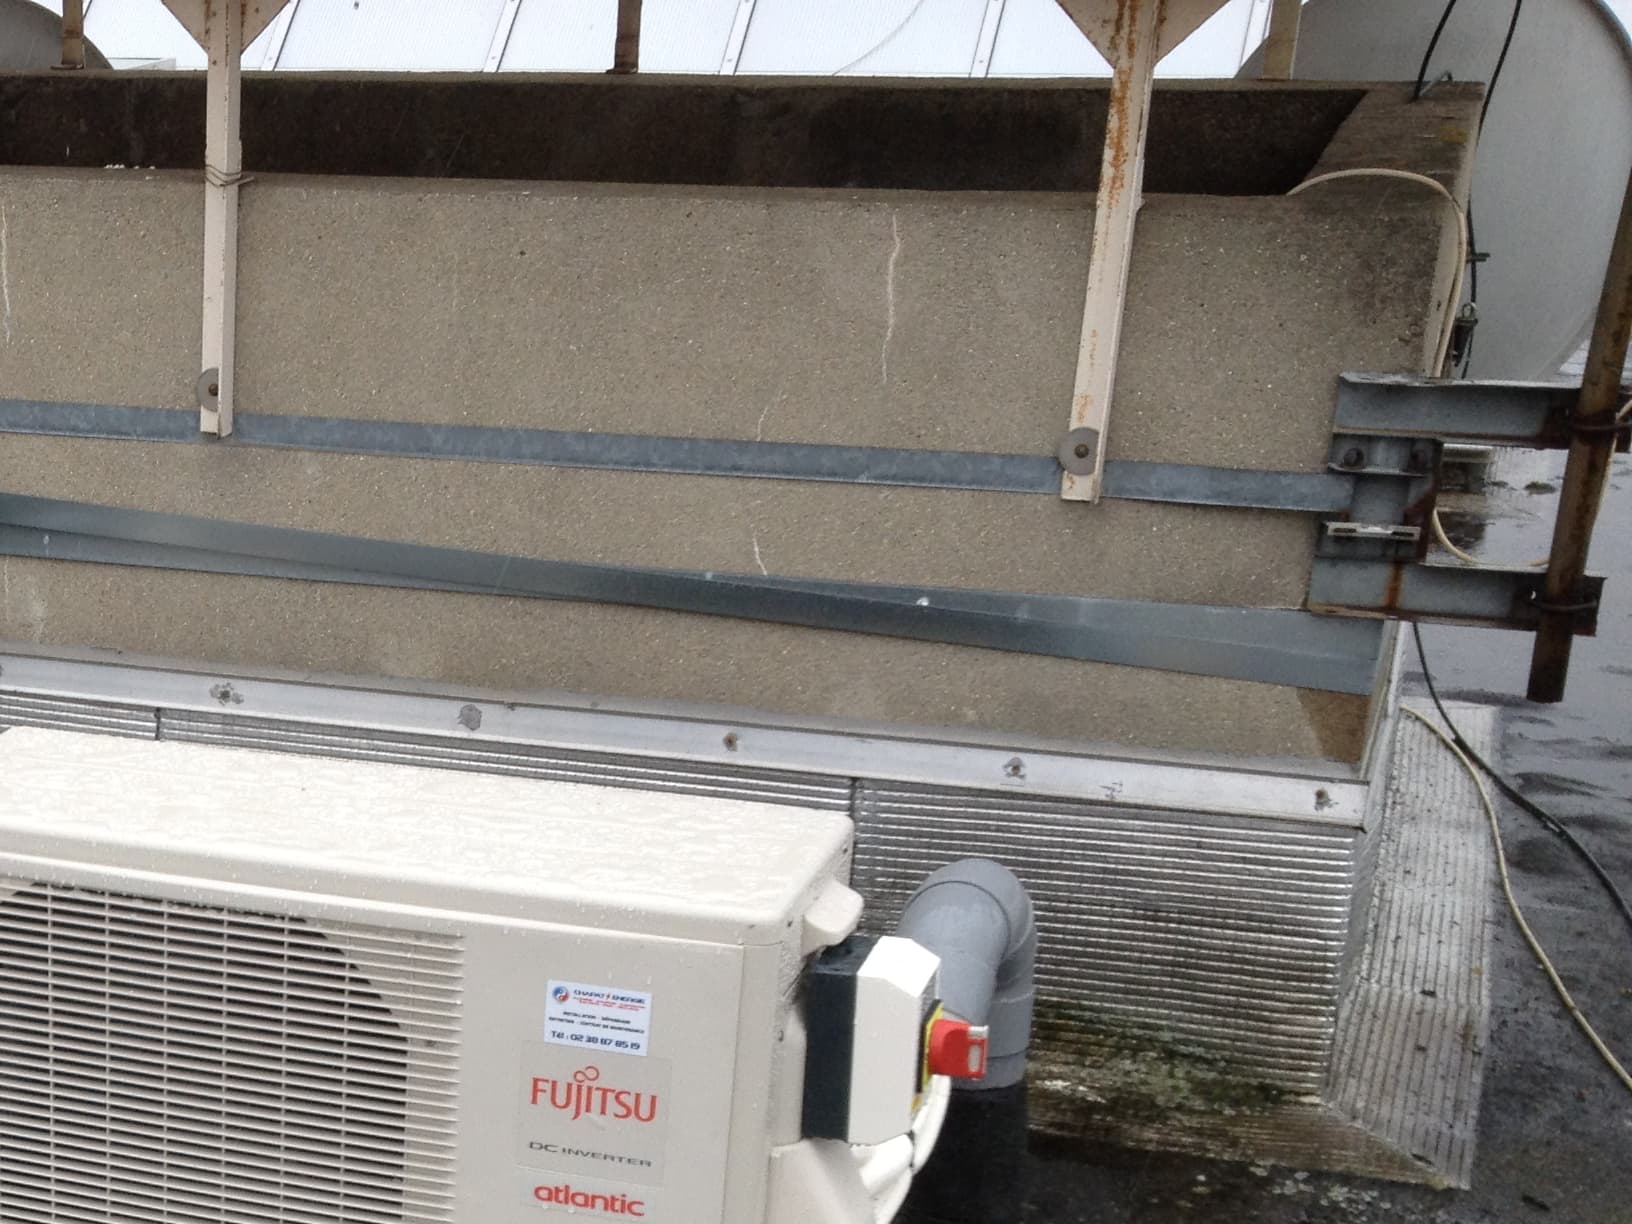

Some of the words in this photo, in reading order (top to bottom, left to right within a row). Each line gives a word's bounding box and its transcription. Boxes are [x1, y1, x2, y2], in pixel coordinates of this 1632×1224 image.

[529, 1075, 658, 1123] FUJITSU
[528, 1141, 558, 1153] DC
[562, 1147, 652, 1167] INVERTER
[533, 1184, 645, 1217] atlantic
